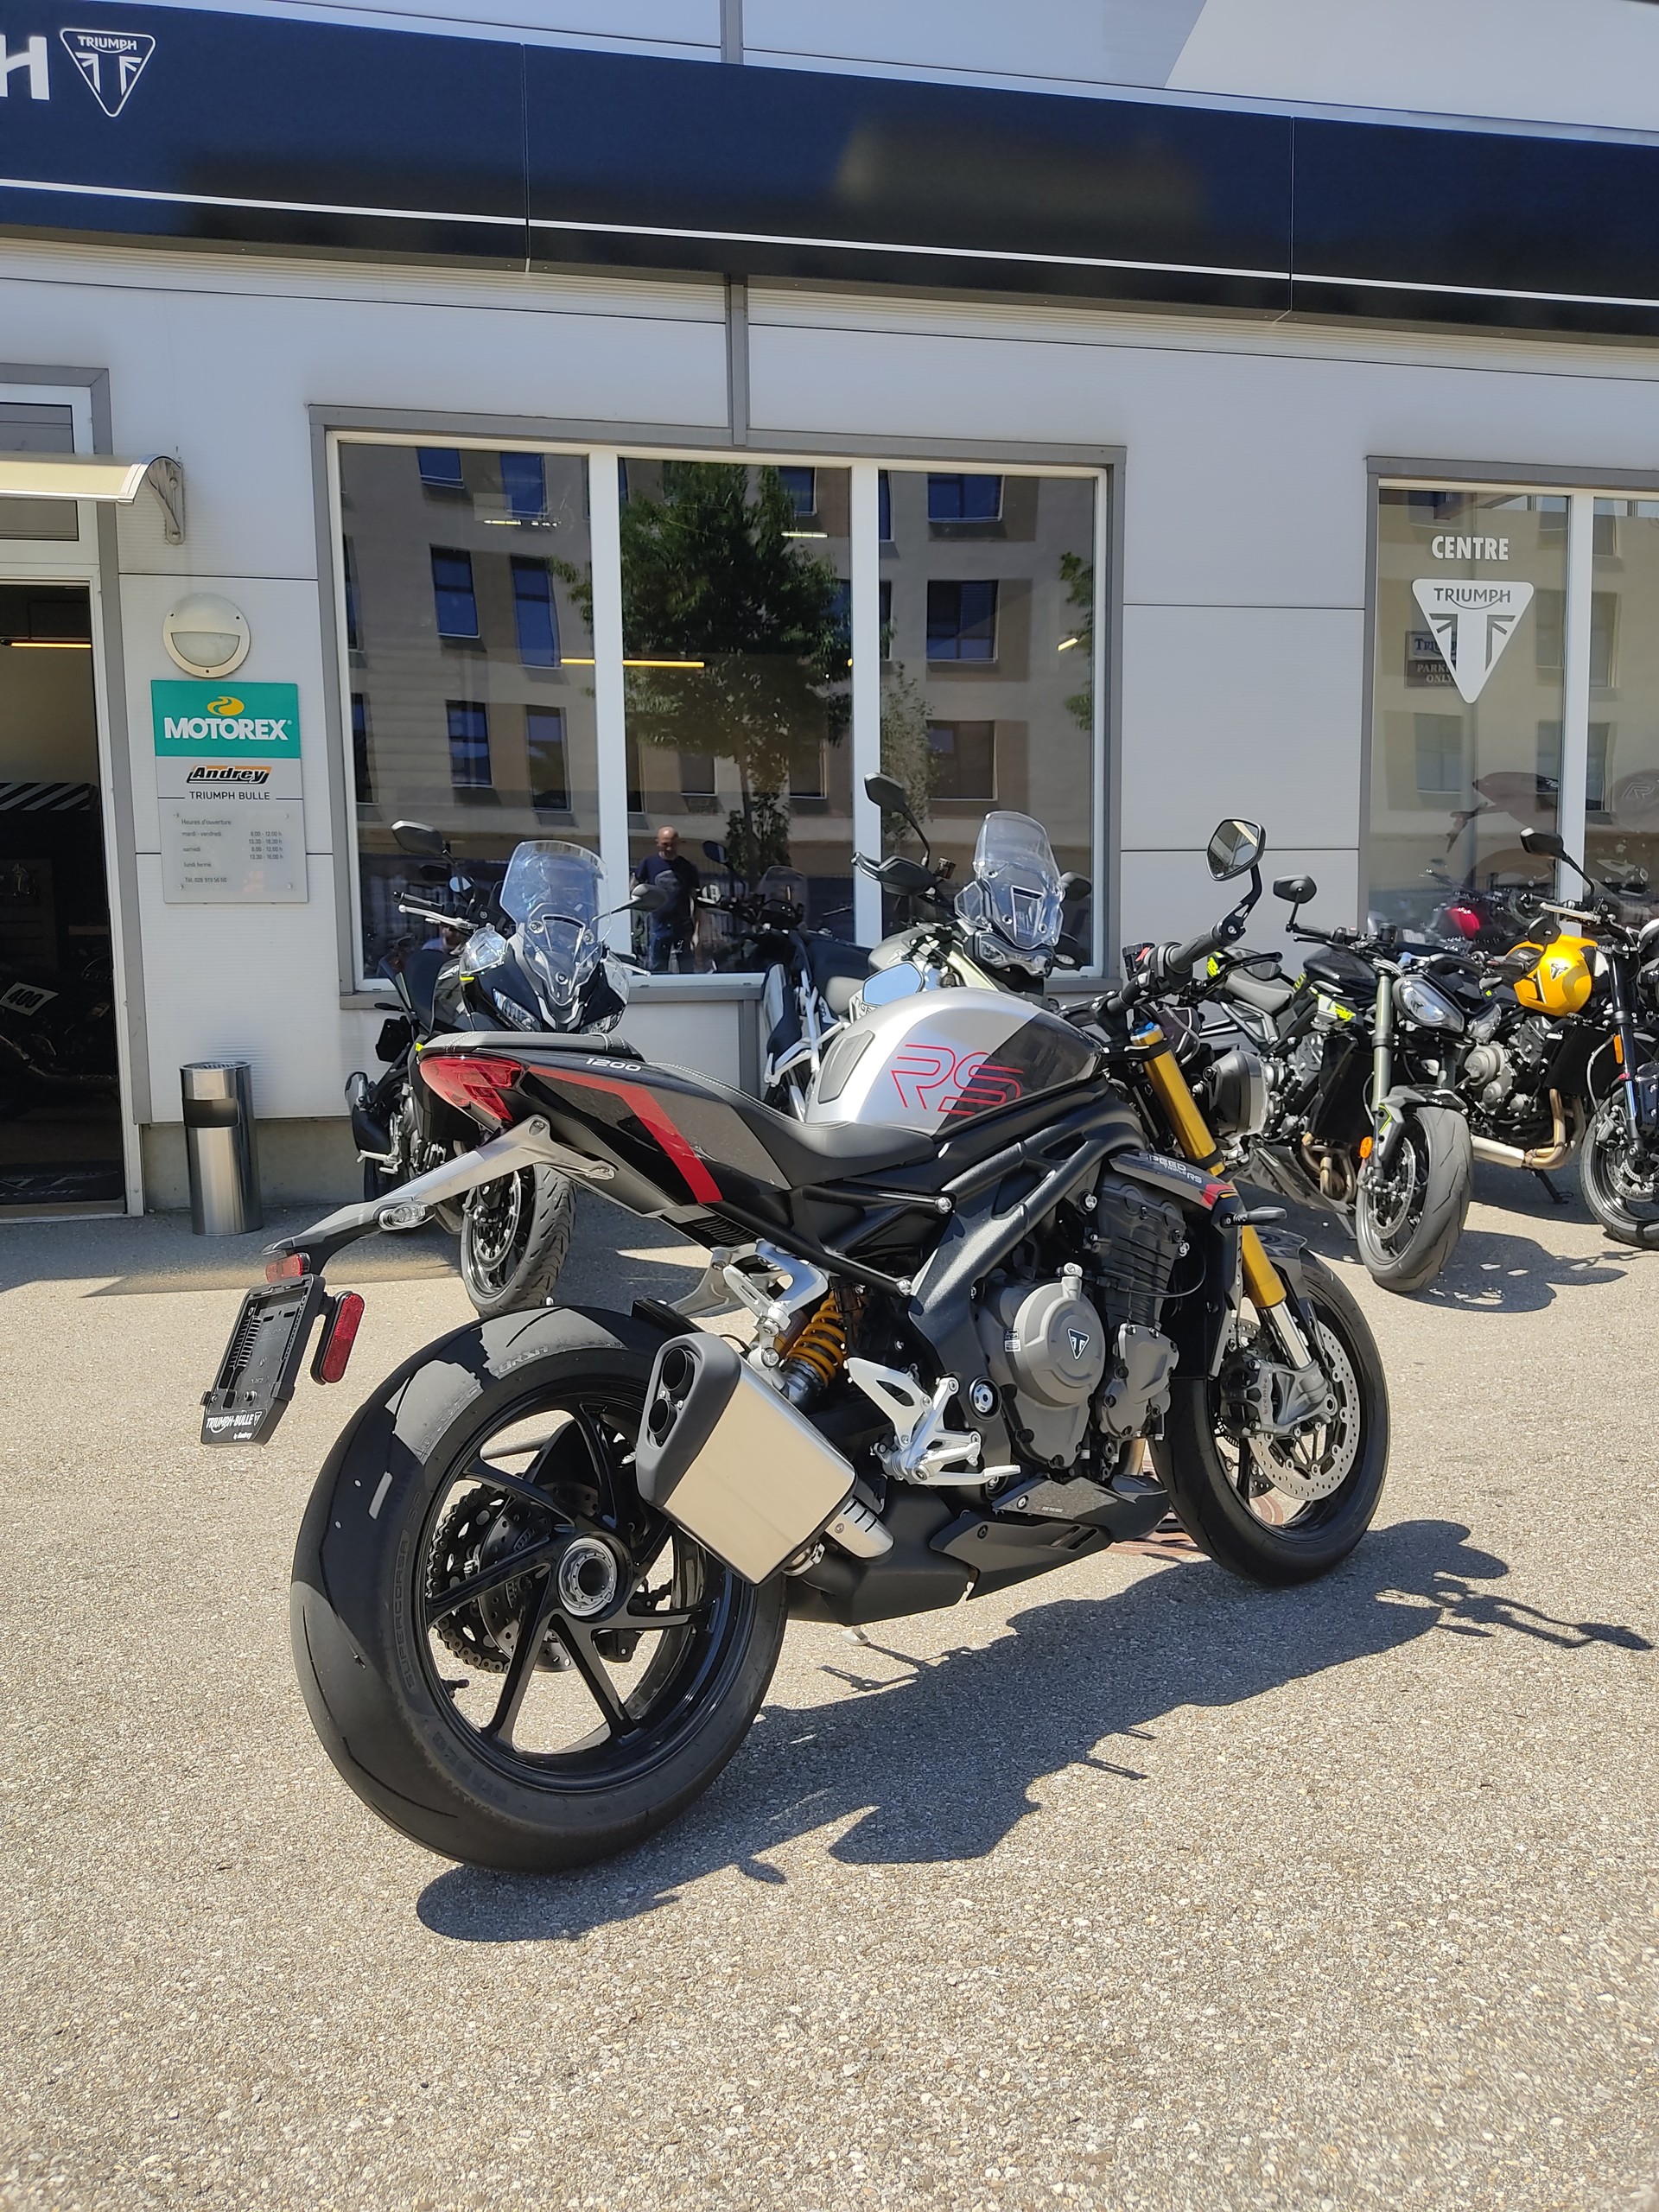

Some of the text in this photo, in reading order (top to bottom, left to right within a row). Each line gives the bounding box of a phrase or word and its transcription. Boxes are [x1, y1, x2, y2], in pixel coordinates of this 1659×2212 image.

[78, 35, 137, 53] TRIUMPH
[1432, 535, 1509, 561] CENTRE
[1433, 588, 1510, 607] TRIUMPH
[192, 766, 266, 783] Andrey
[189, 791, 270, 800] TRIUMPH BULLE
[586, 1058, 642, 1071] 1200
[891, 1043, 1025, 1116] RS
[1139, 1153, 1186, 1172] SPEED
[1186, 1172, 1203, 1184] RS
[393, 1540, 416, 1689] SUPERCORSA
